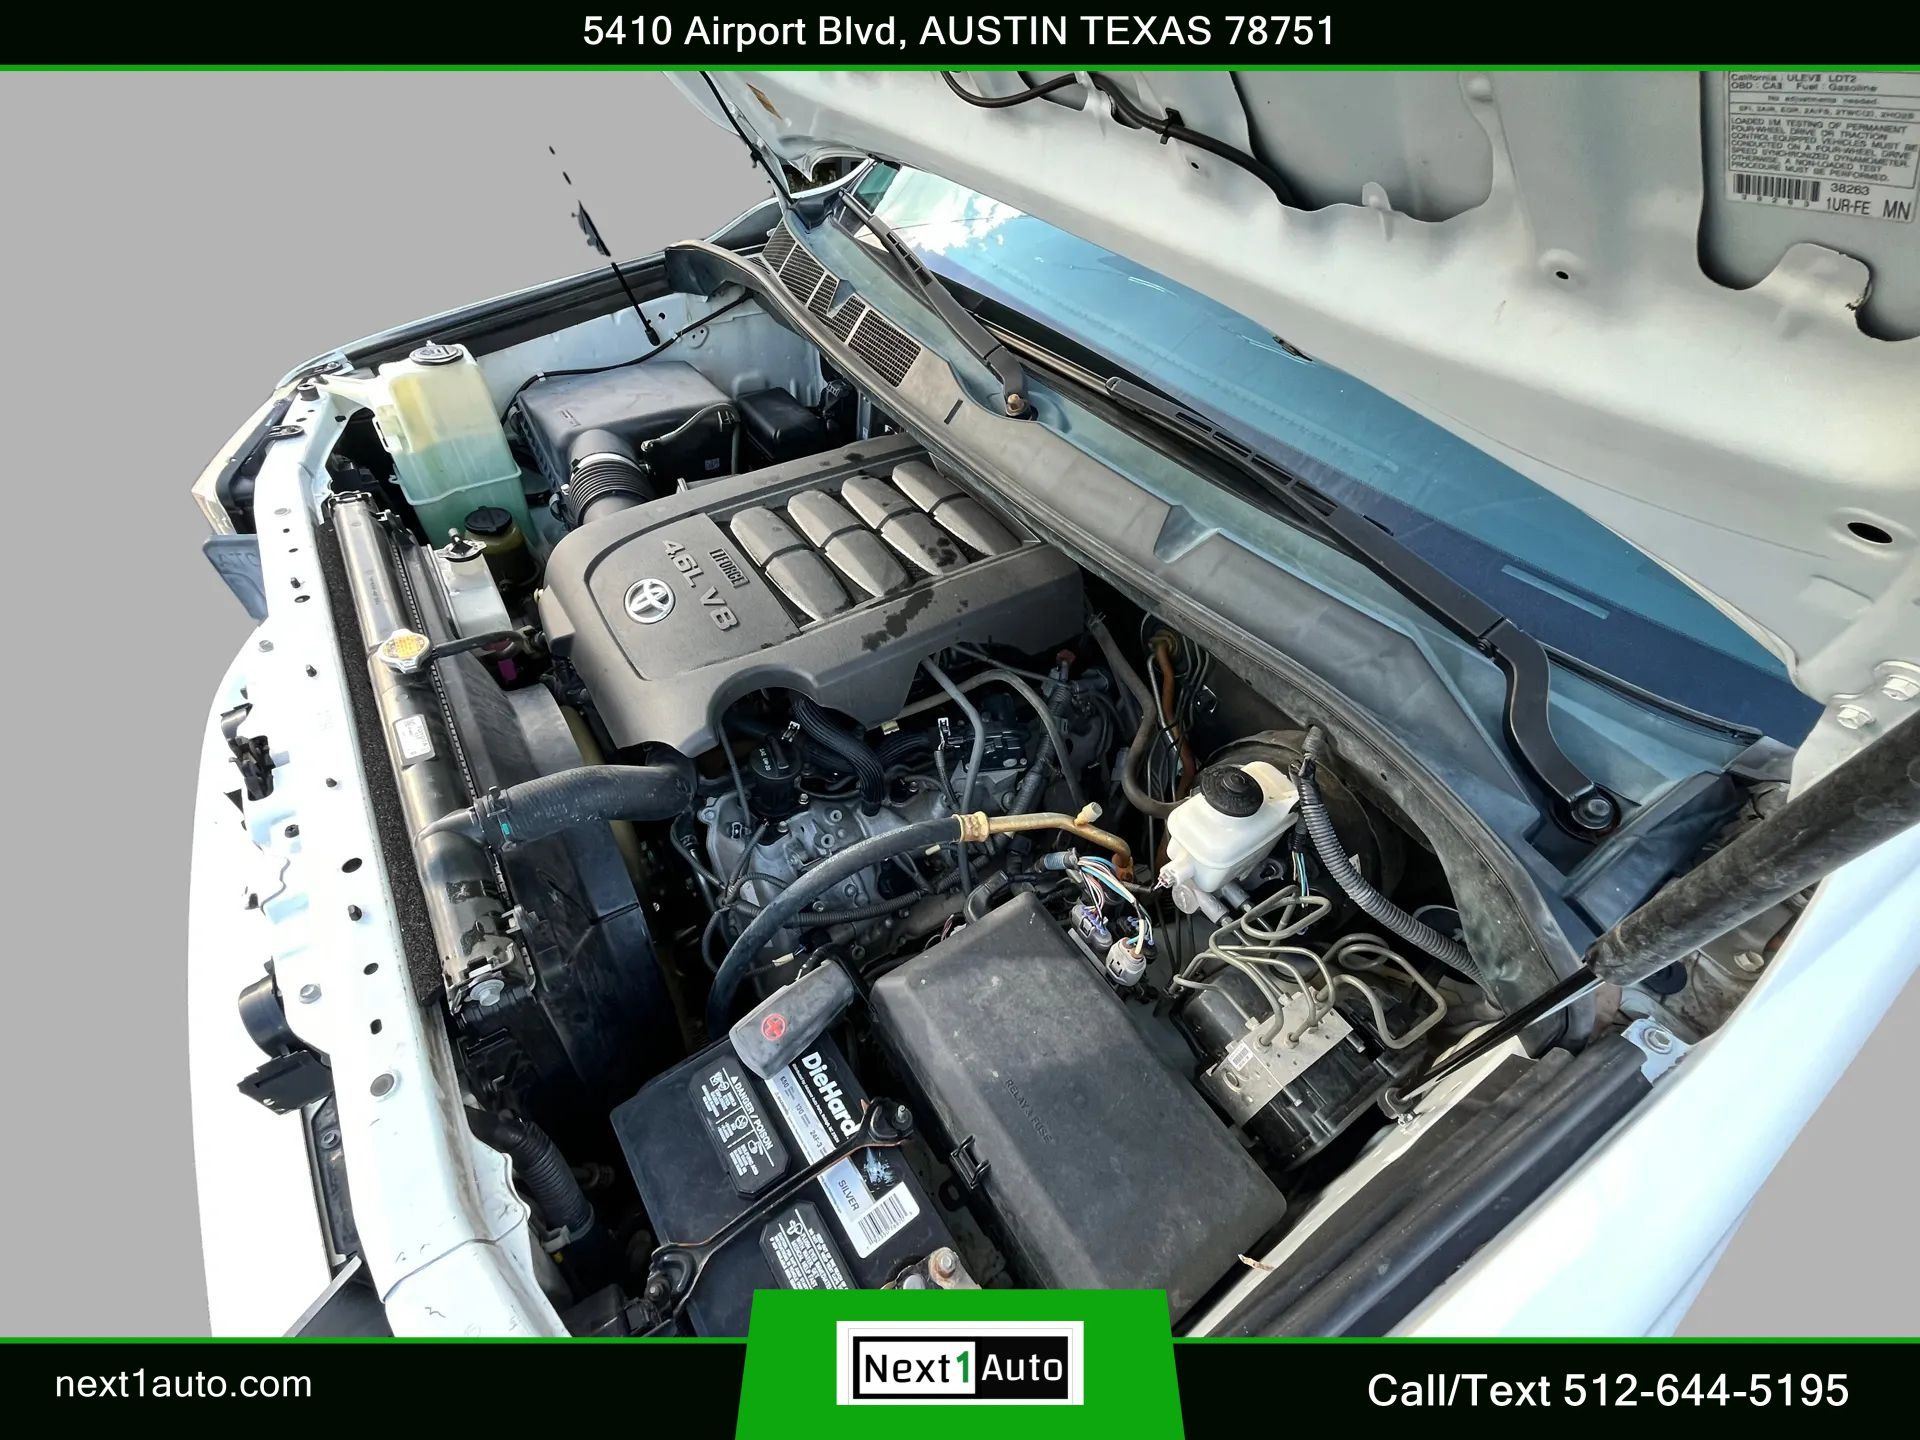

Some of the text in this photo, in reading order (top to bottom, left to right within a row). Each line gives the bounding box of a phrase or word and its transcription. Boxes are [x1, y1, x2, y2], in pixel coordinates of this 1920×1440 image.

[1731, 73, 1777, 81] California
[1828, 75, 1857, 83] LDT2
[1828, 84, 1878, 92] Gasoline
[1786, 120, 1824, 128] TESTING
[1828, 121, 1842, 129] OF
[1847, 123, 1908, 134] PERMANENT
[1790, 128, 1816, 136] DRIVE
[1841, 131, 1888, 140] TRACTION
[1732, 140, 1784, 149] CONDUCTED
[1881, 150, 1912, 159] DRIVE
[1822, 138, 1867, 147] VEHICLES
[1872, 141, 1900, 149] MUST
[1762, 149, 1829, 160] SYNCHRONIZED
[1732, 161, 1780, 171] PROCEDURE
[1860, 164, 1882, 172] TEST
[1830, 183, 1870, 196] 38263
[1826, 197, 1912, 221] 1UR-FE MN
[701, 586, 739, 632] V8
[801, 1051, 861, 1139] DieHard
[795, 1103, 804, 1114] 130
[735, 1083, 754, 1115] DANGER
[753, 1118, 773, 1150] POISON
[838, 1179, 859, 1211] SILVER
[806, 1274, 818, 1288] FAST
